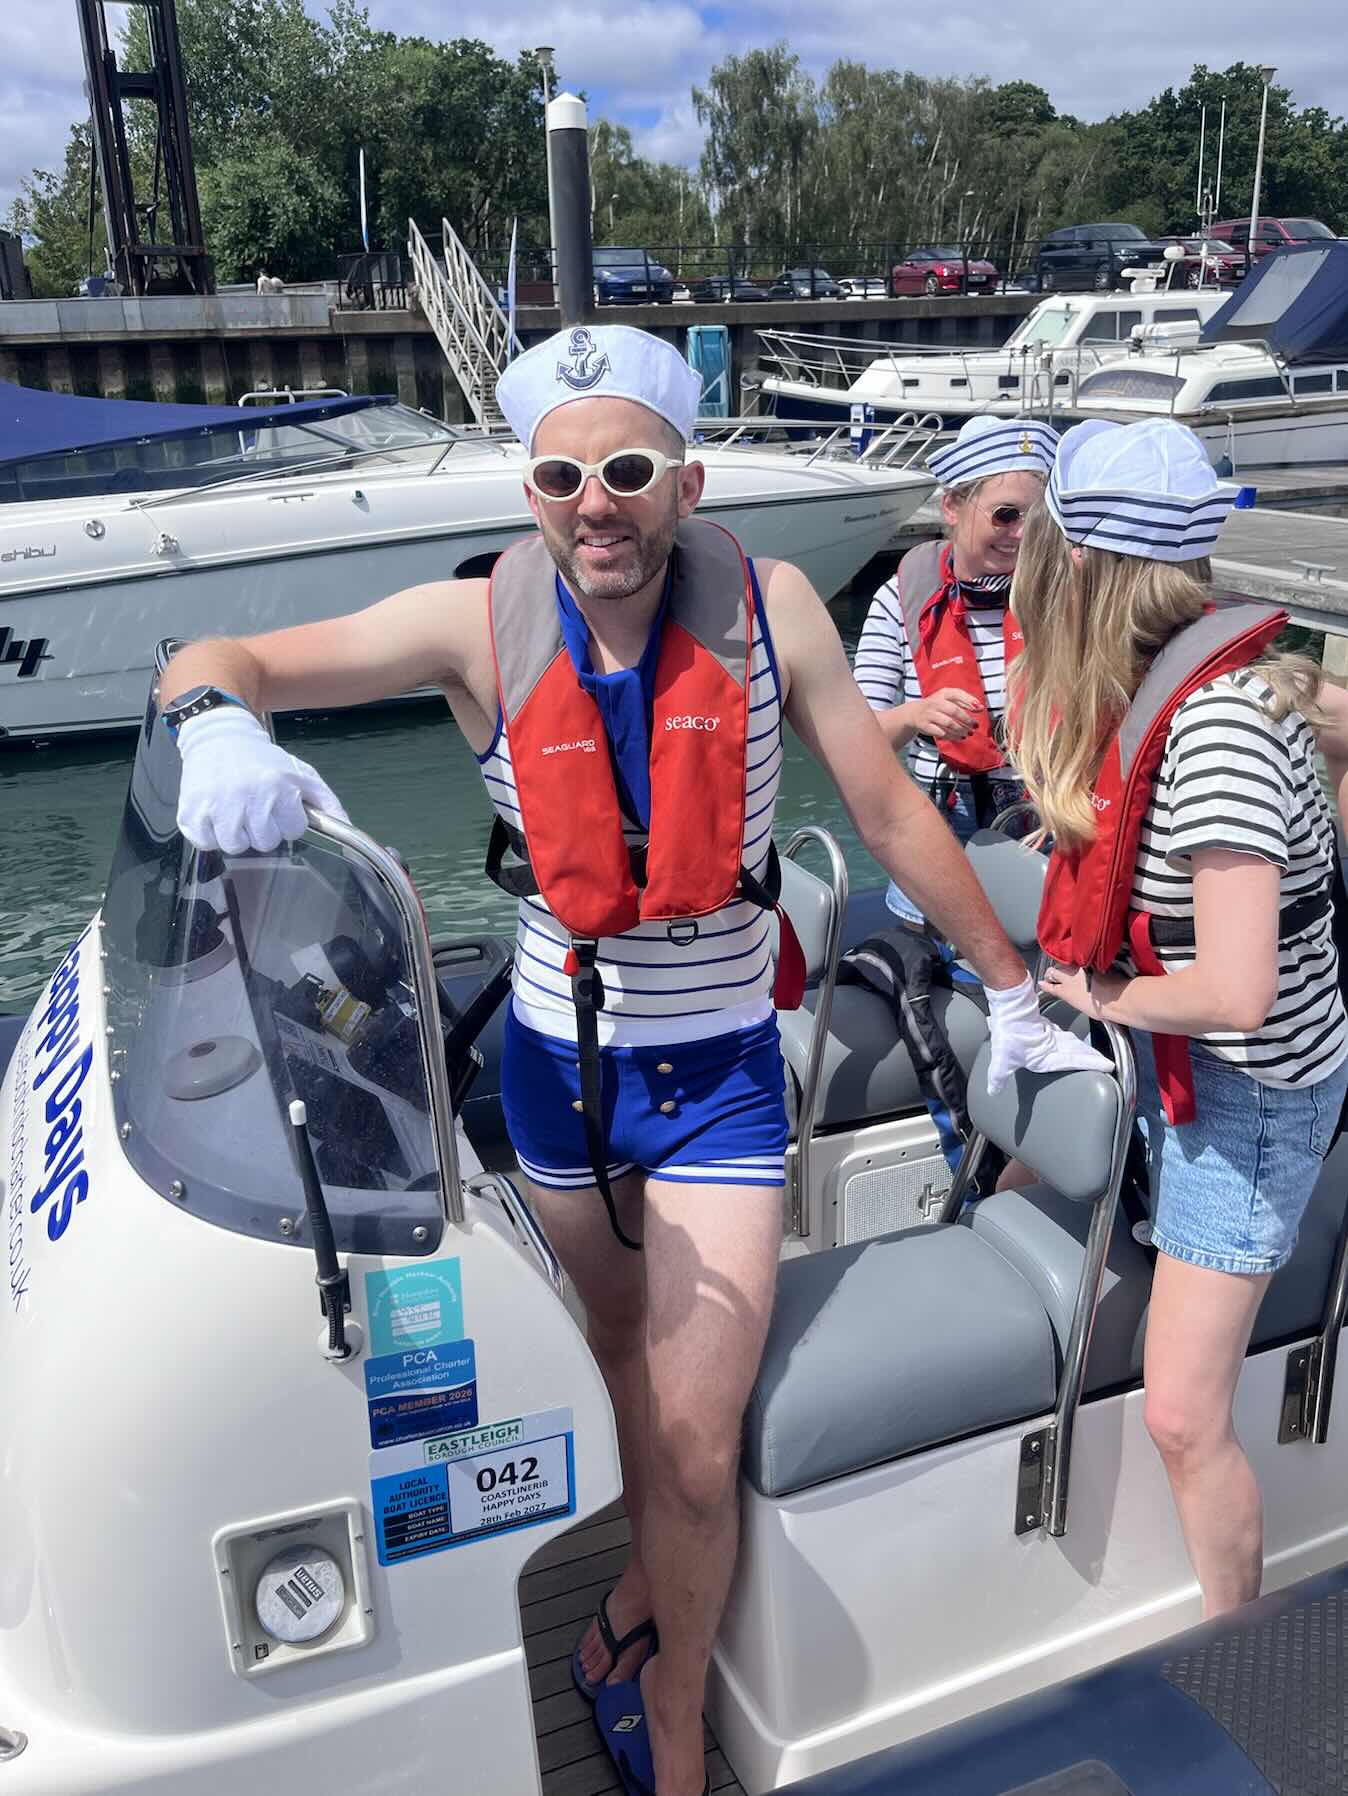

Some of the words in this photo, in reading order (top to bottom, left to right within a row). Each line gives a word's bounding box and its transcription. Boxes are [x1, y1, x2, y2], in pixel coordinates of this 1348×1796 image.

[541, 739, 595, 756] SEAGUARD
[31, 1041, 93, 1242] Days
[402, 1350, 438, 1368] PCA
[369, 1366, 432, 1385] Professional
[433, 1357, 471, 1371] Charter
[392, 1371, 450, 1389] Association
[372, 1407, 397, 1417] PCA
[397, 1394, 448, 1412] MEMBER
[428, 1424, 520, 1456] EASTLEIGH
[428, 1445, 474, 1461] BOROUGH
[478, 1435, 520, 1450] COUNCIL
[399, 1477, 428, 1490] LOCAL
[476, 1457, 540, 1493] 042
[384, 1502, 407, 1514] BOAT
[410, 1492, 447, 1508] LICENCE
[389, 1484, 440, 1503] AUTHORITY
[480, 1480, 549, 1503] COASTLINERIB
[483, 1498, 515, 1513] HAPPY
[517, 1491, 542, 1504] DAYS
[480, 1515, 502, 1527] 28th
[505, 1508, 522, 1519] Feb
[523, 1502, 547, 1515] 2027
